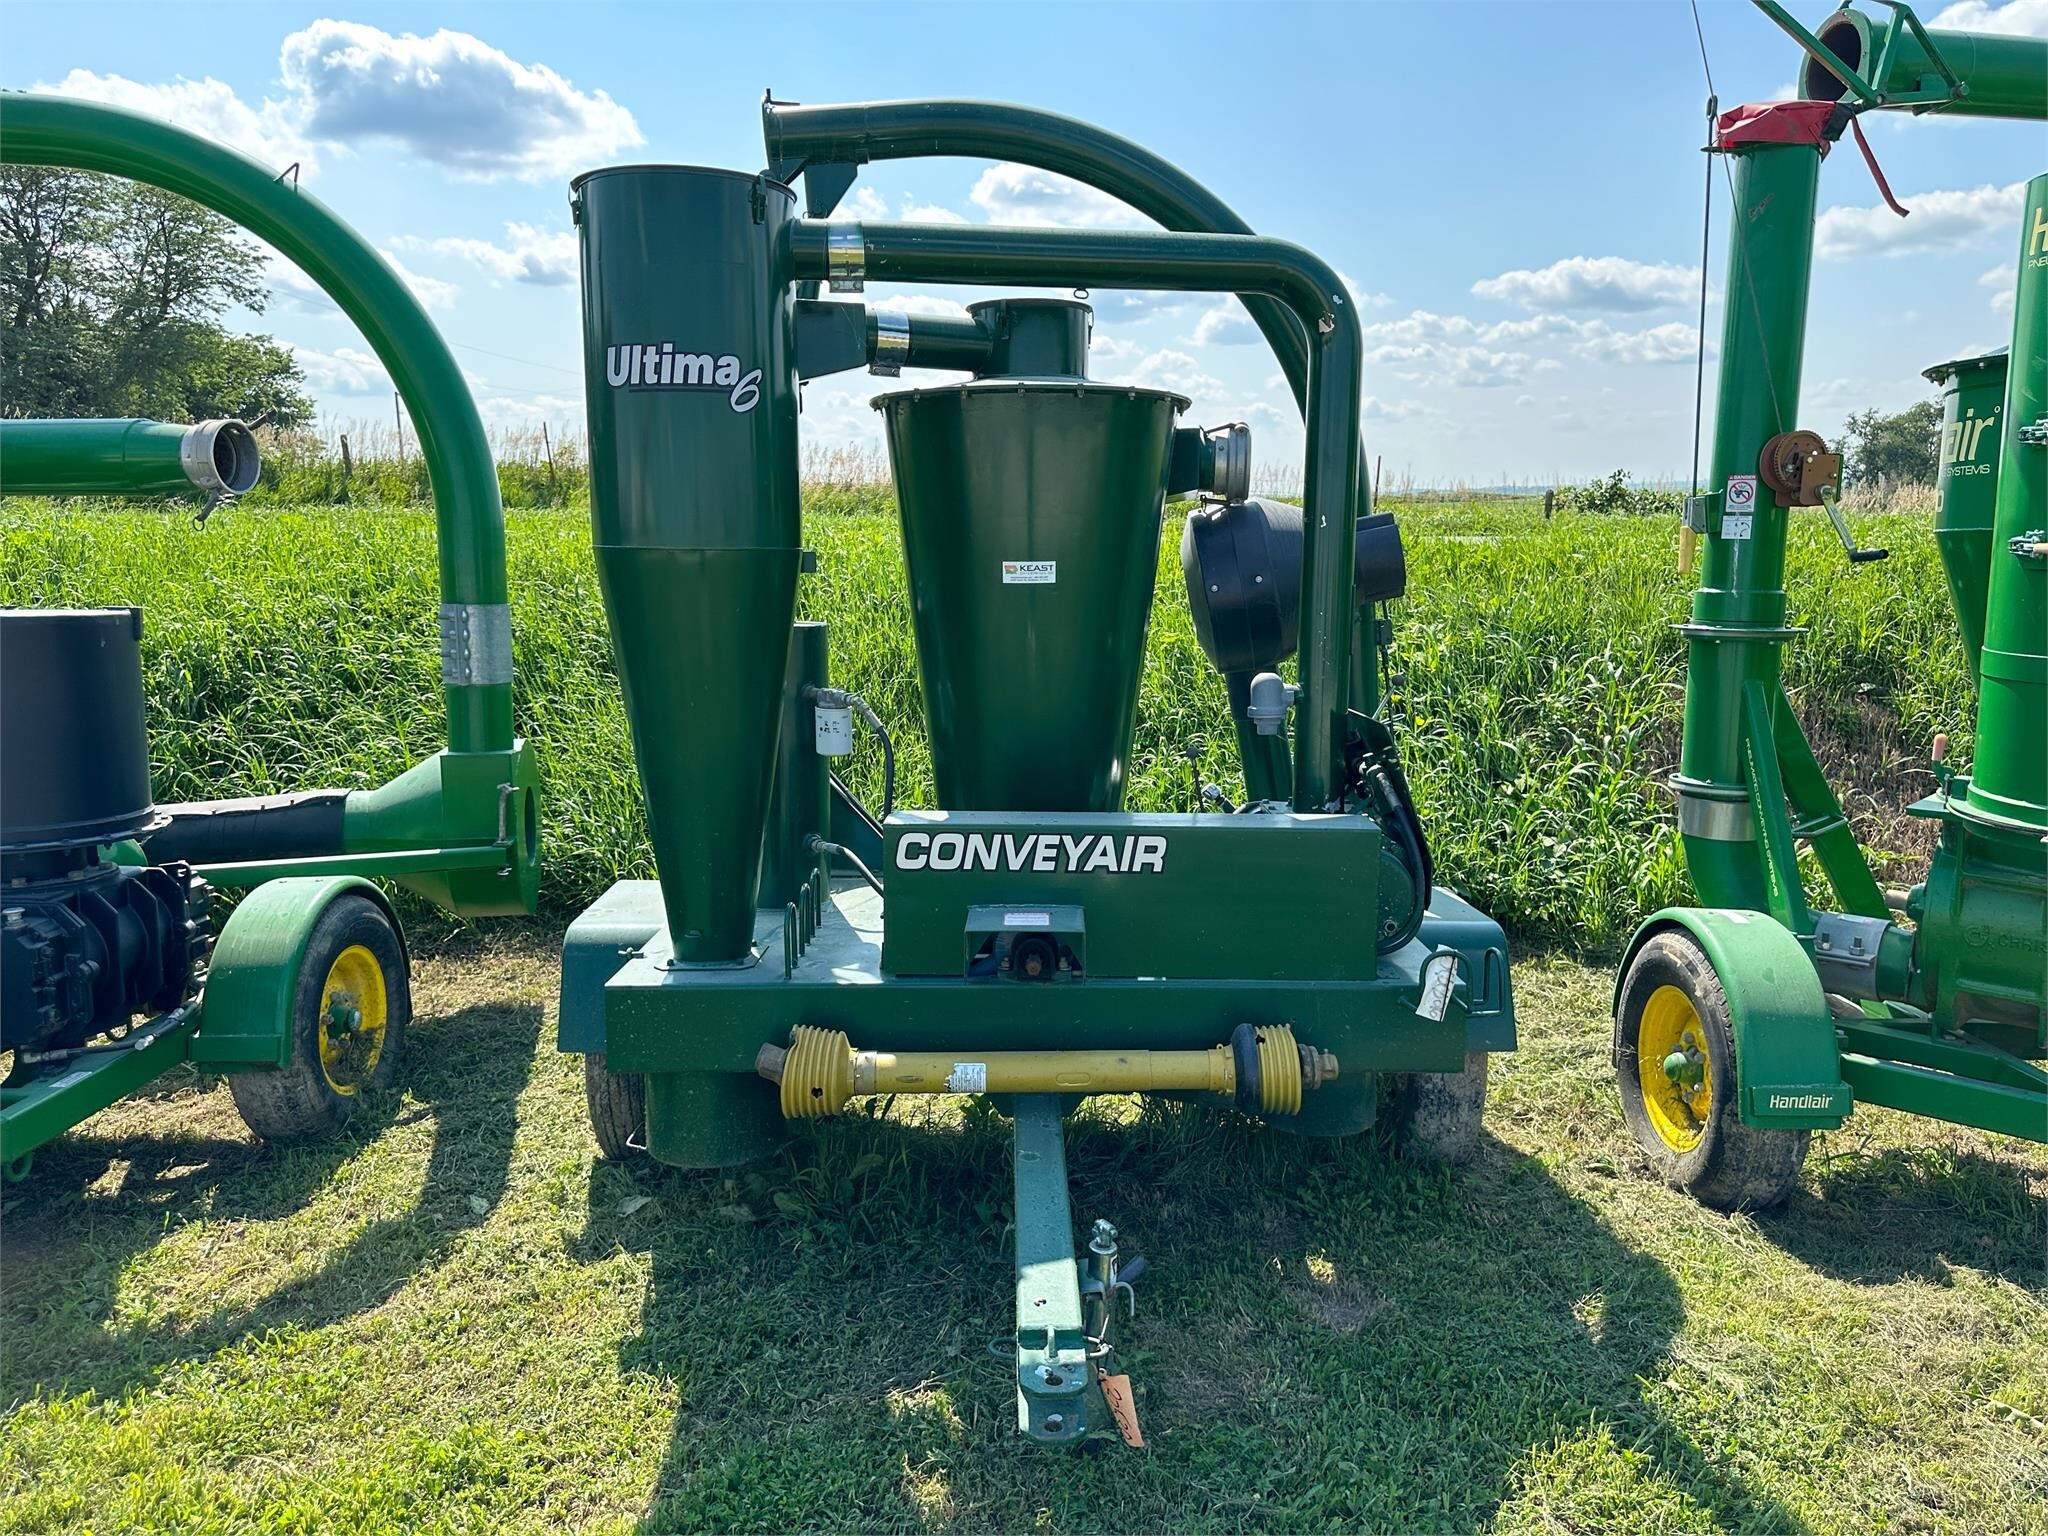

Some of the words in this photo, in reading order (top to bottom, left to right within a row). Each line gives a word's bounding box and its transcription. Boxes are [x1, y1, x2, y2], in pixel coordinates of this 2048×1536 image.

[606, 342, 741, 387] Ultima
[730, 368, 763, 413] 6
[1946, 464, 1990, 477] SYSTEMS
[1019, 564, 1055, 572] KEAST
[895, 831, 1168, 873] CONVEYAIR
[1766, 849, 1779, 897] SYSTEMS
[1769, 1094, 1833, 1109] Handlair
